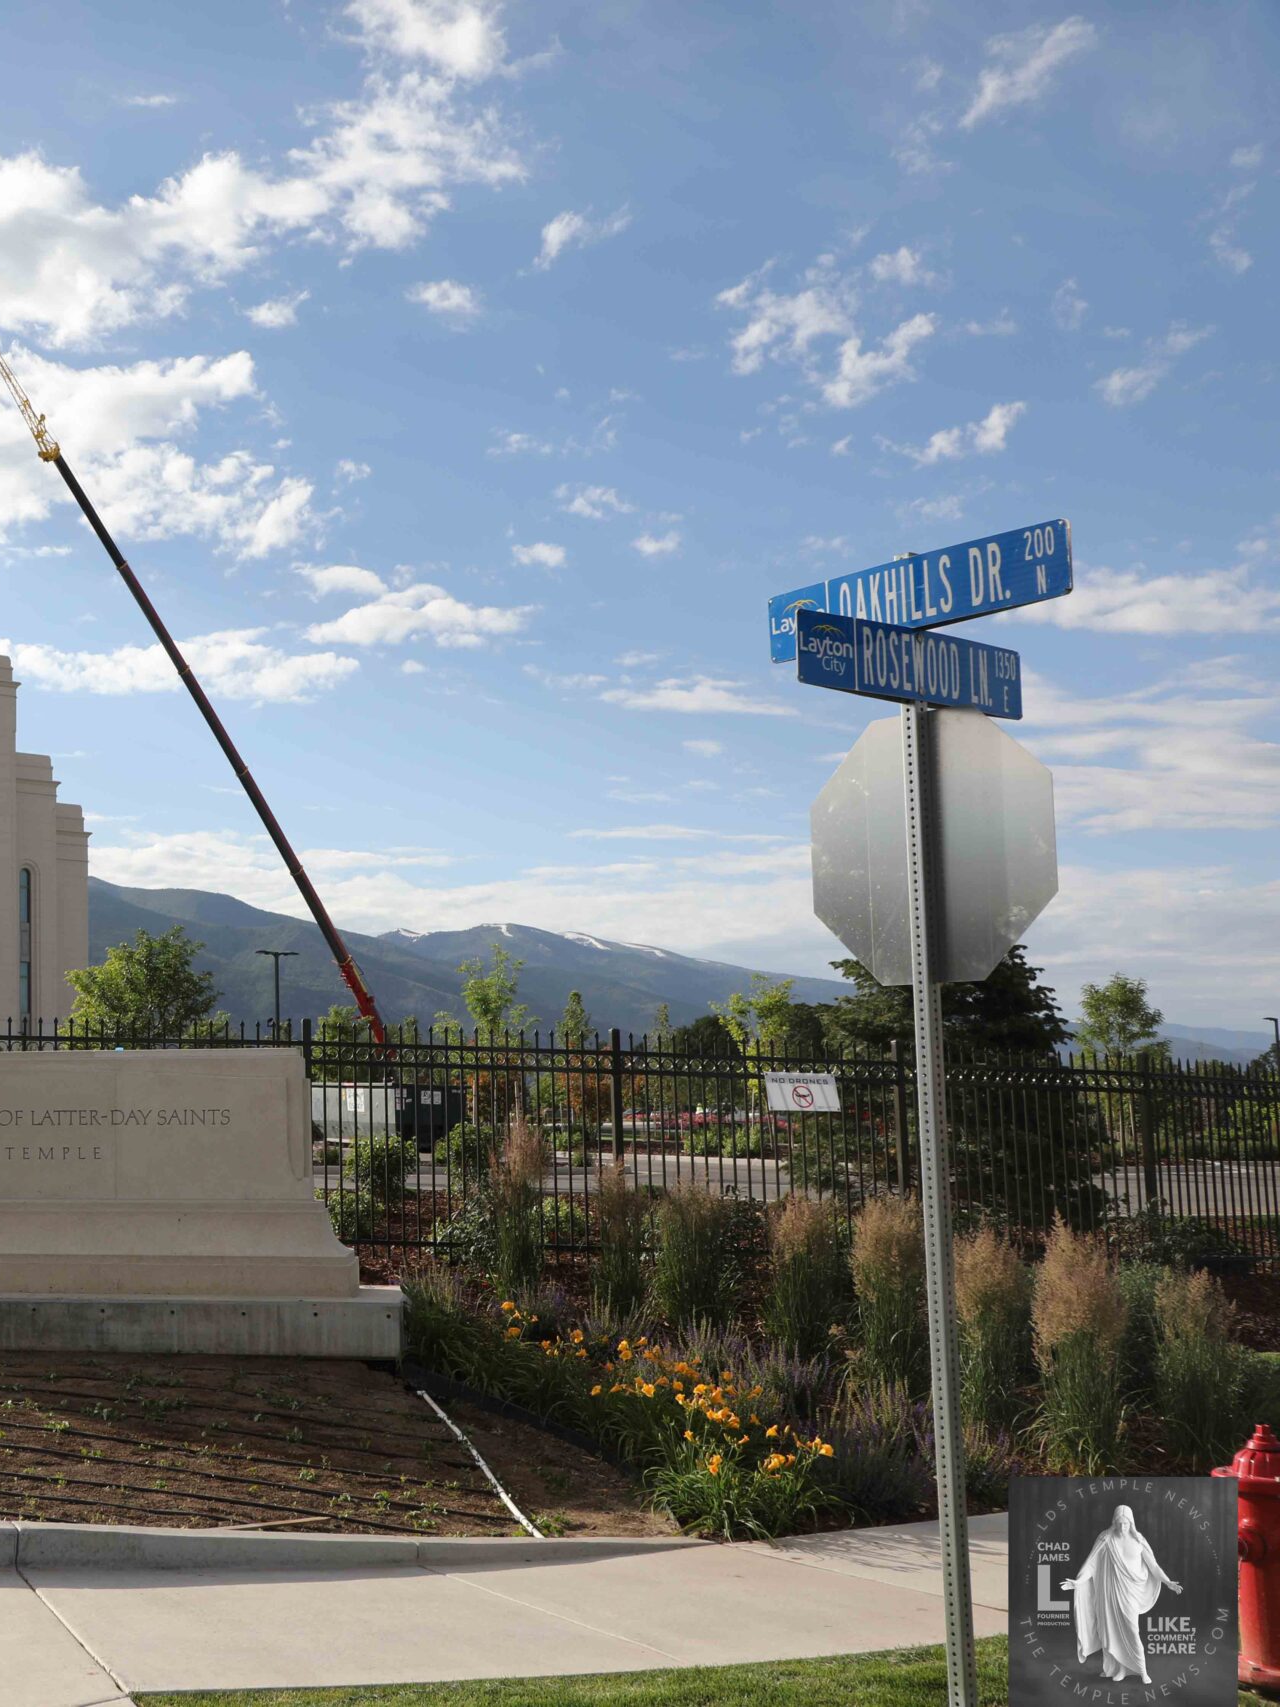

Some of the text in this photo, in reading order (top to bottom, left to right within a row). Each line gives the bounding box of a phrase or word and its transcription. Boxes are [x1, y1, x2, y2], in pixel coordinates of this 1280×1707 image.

[1024, 526, 1055, 561] 200
[839, 542, 1011, 625] OAKHILLS DR.
[1036, 565, 1047, 595] N
[800, 631, 853, 659] Layton
[822, 656, 846, 676] City
[862, 626, 993, 708] ROSEWOOD LN.
[994, 650, 1017, 681] 1350
[1003, 685, 1010, 713] E
[788, 1077, 829, 1085] DRONES
[30, 1109, 153, 1126] LATTER-DAY
[156, 1109, 231, 1126] SAINTS
[4, 1146, 102, 1161] TEMPLE
